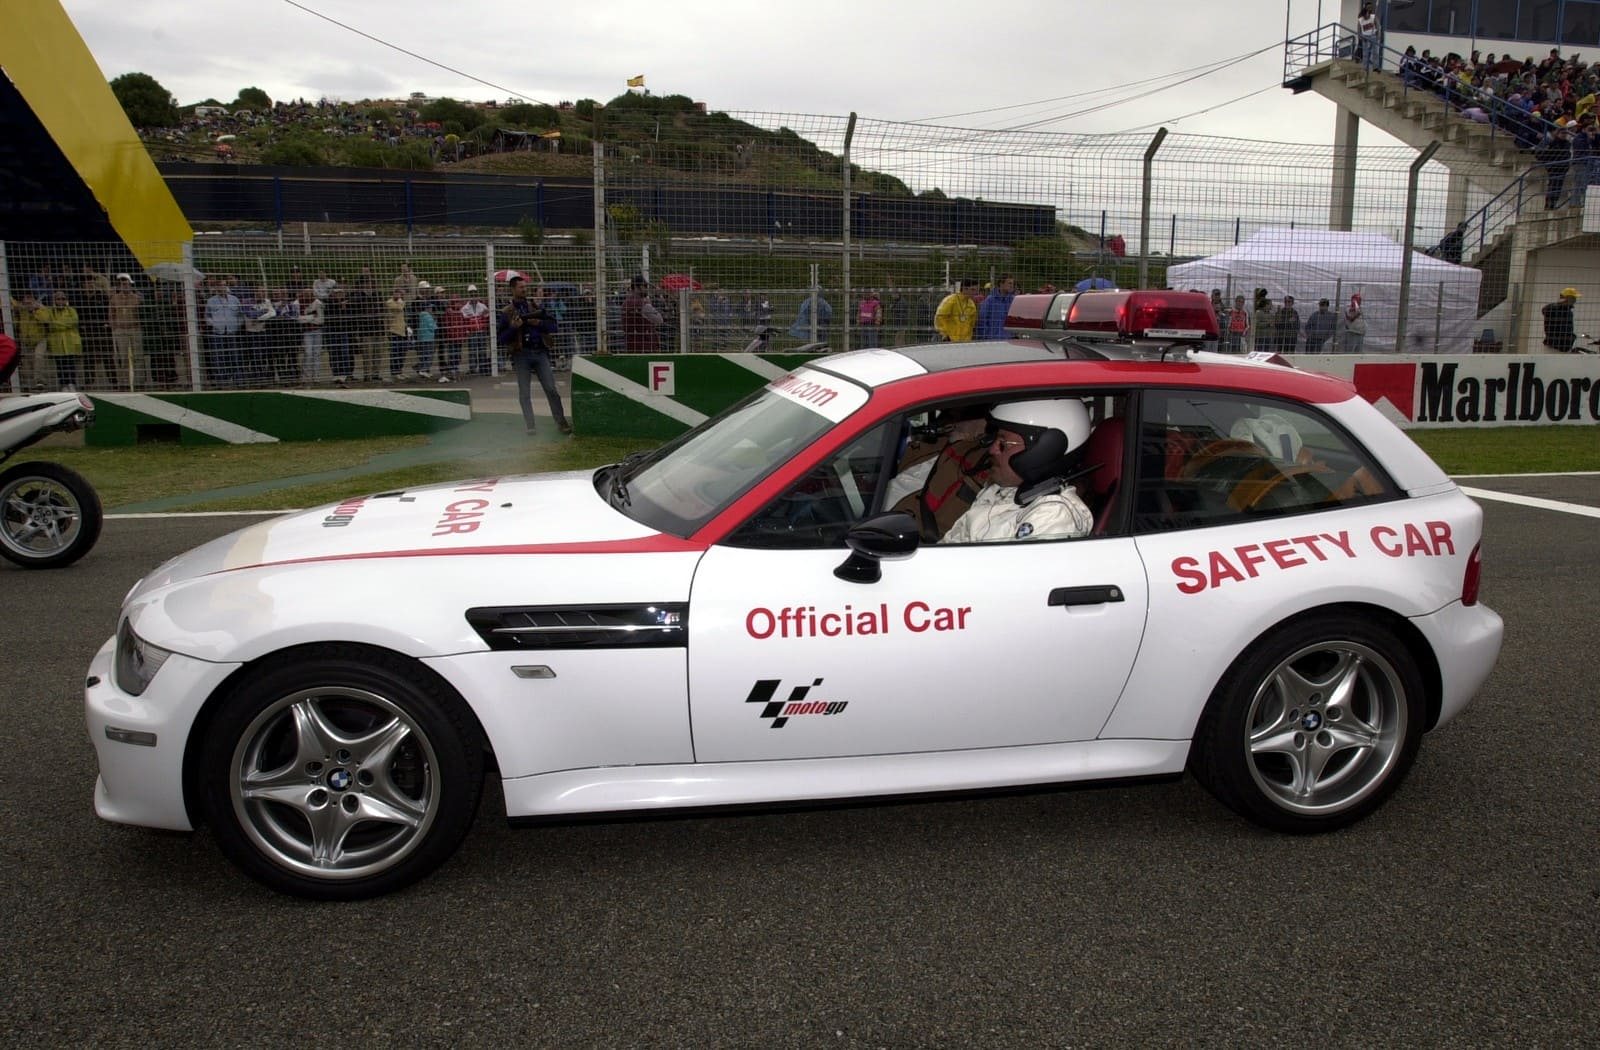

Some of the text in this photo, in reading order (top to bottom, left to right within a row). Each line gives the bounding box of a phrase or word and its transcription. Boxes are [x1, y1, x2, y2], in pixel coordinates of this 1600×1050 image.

[653, 366, 670, 391] F
[431, 499, 489, 536] CAR
[1171, 520, 1456, 594] SAFETY CAR
[745, 601, 972, 640] Official Car
[783, 700, 848, 716] motogp
